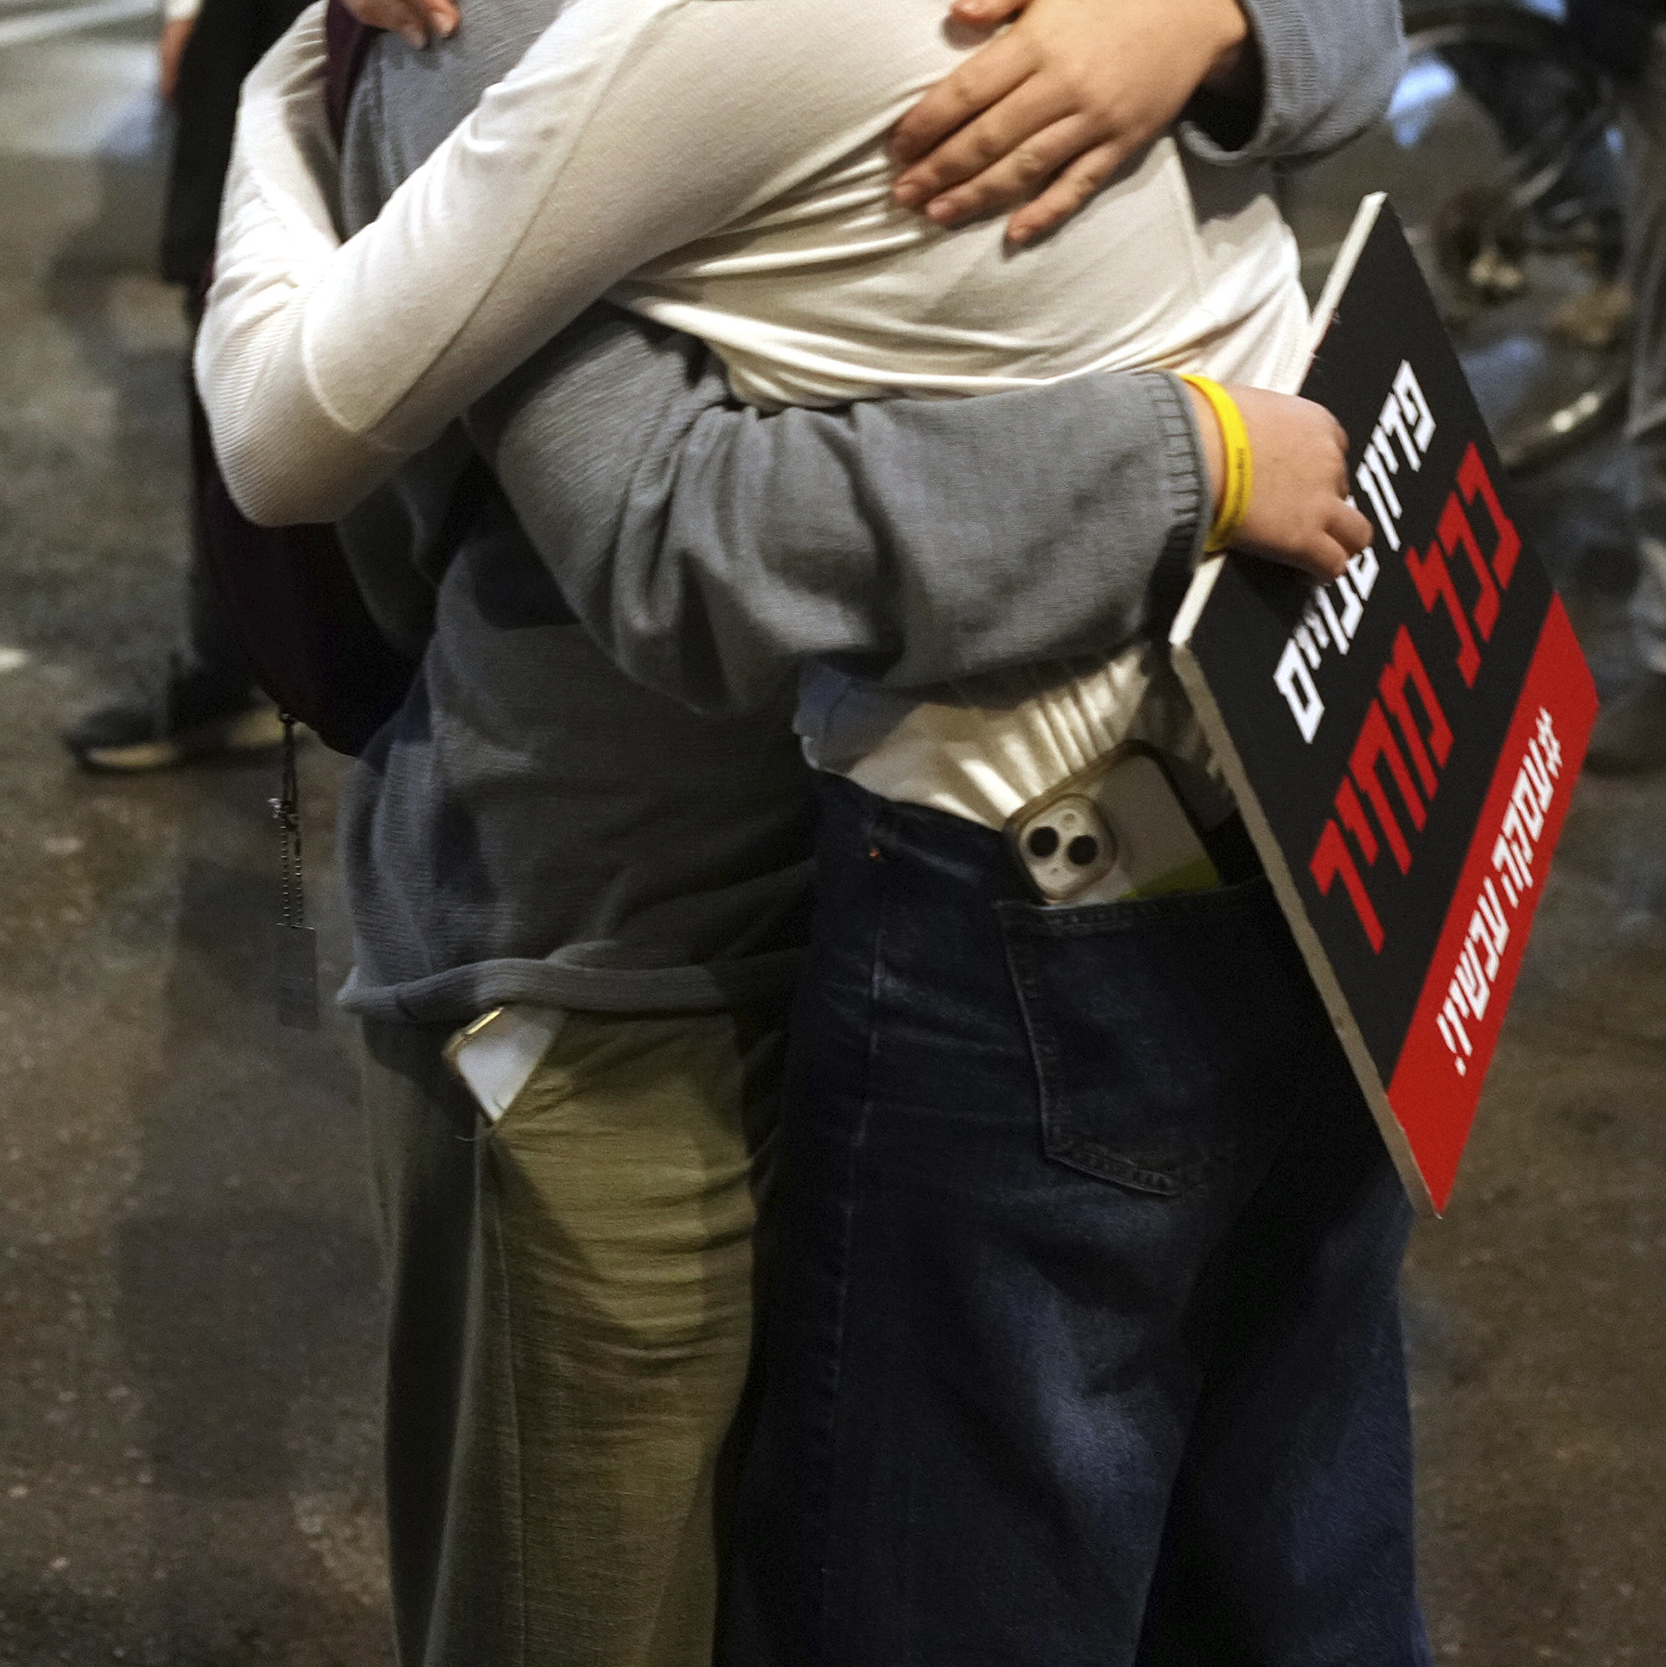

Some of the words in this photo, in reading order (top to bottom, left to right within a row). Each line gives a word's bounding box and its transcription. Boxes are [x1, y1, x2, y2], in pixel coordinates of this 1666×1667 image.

[1355, 359, 1437, 552] פדיון
[1404, 440, 1522, 690] בכל
[1309, 623, 1455, 956] מחיר
[1490, 705, 1563, 909] #עסקה
[1435, 875, 1511, 1077] עכשיו!
